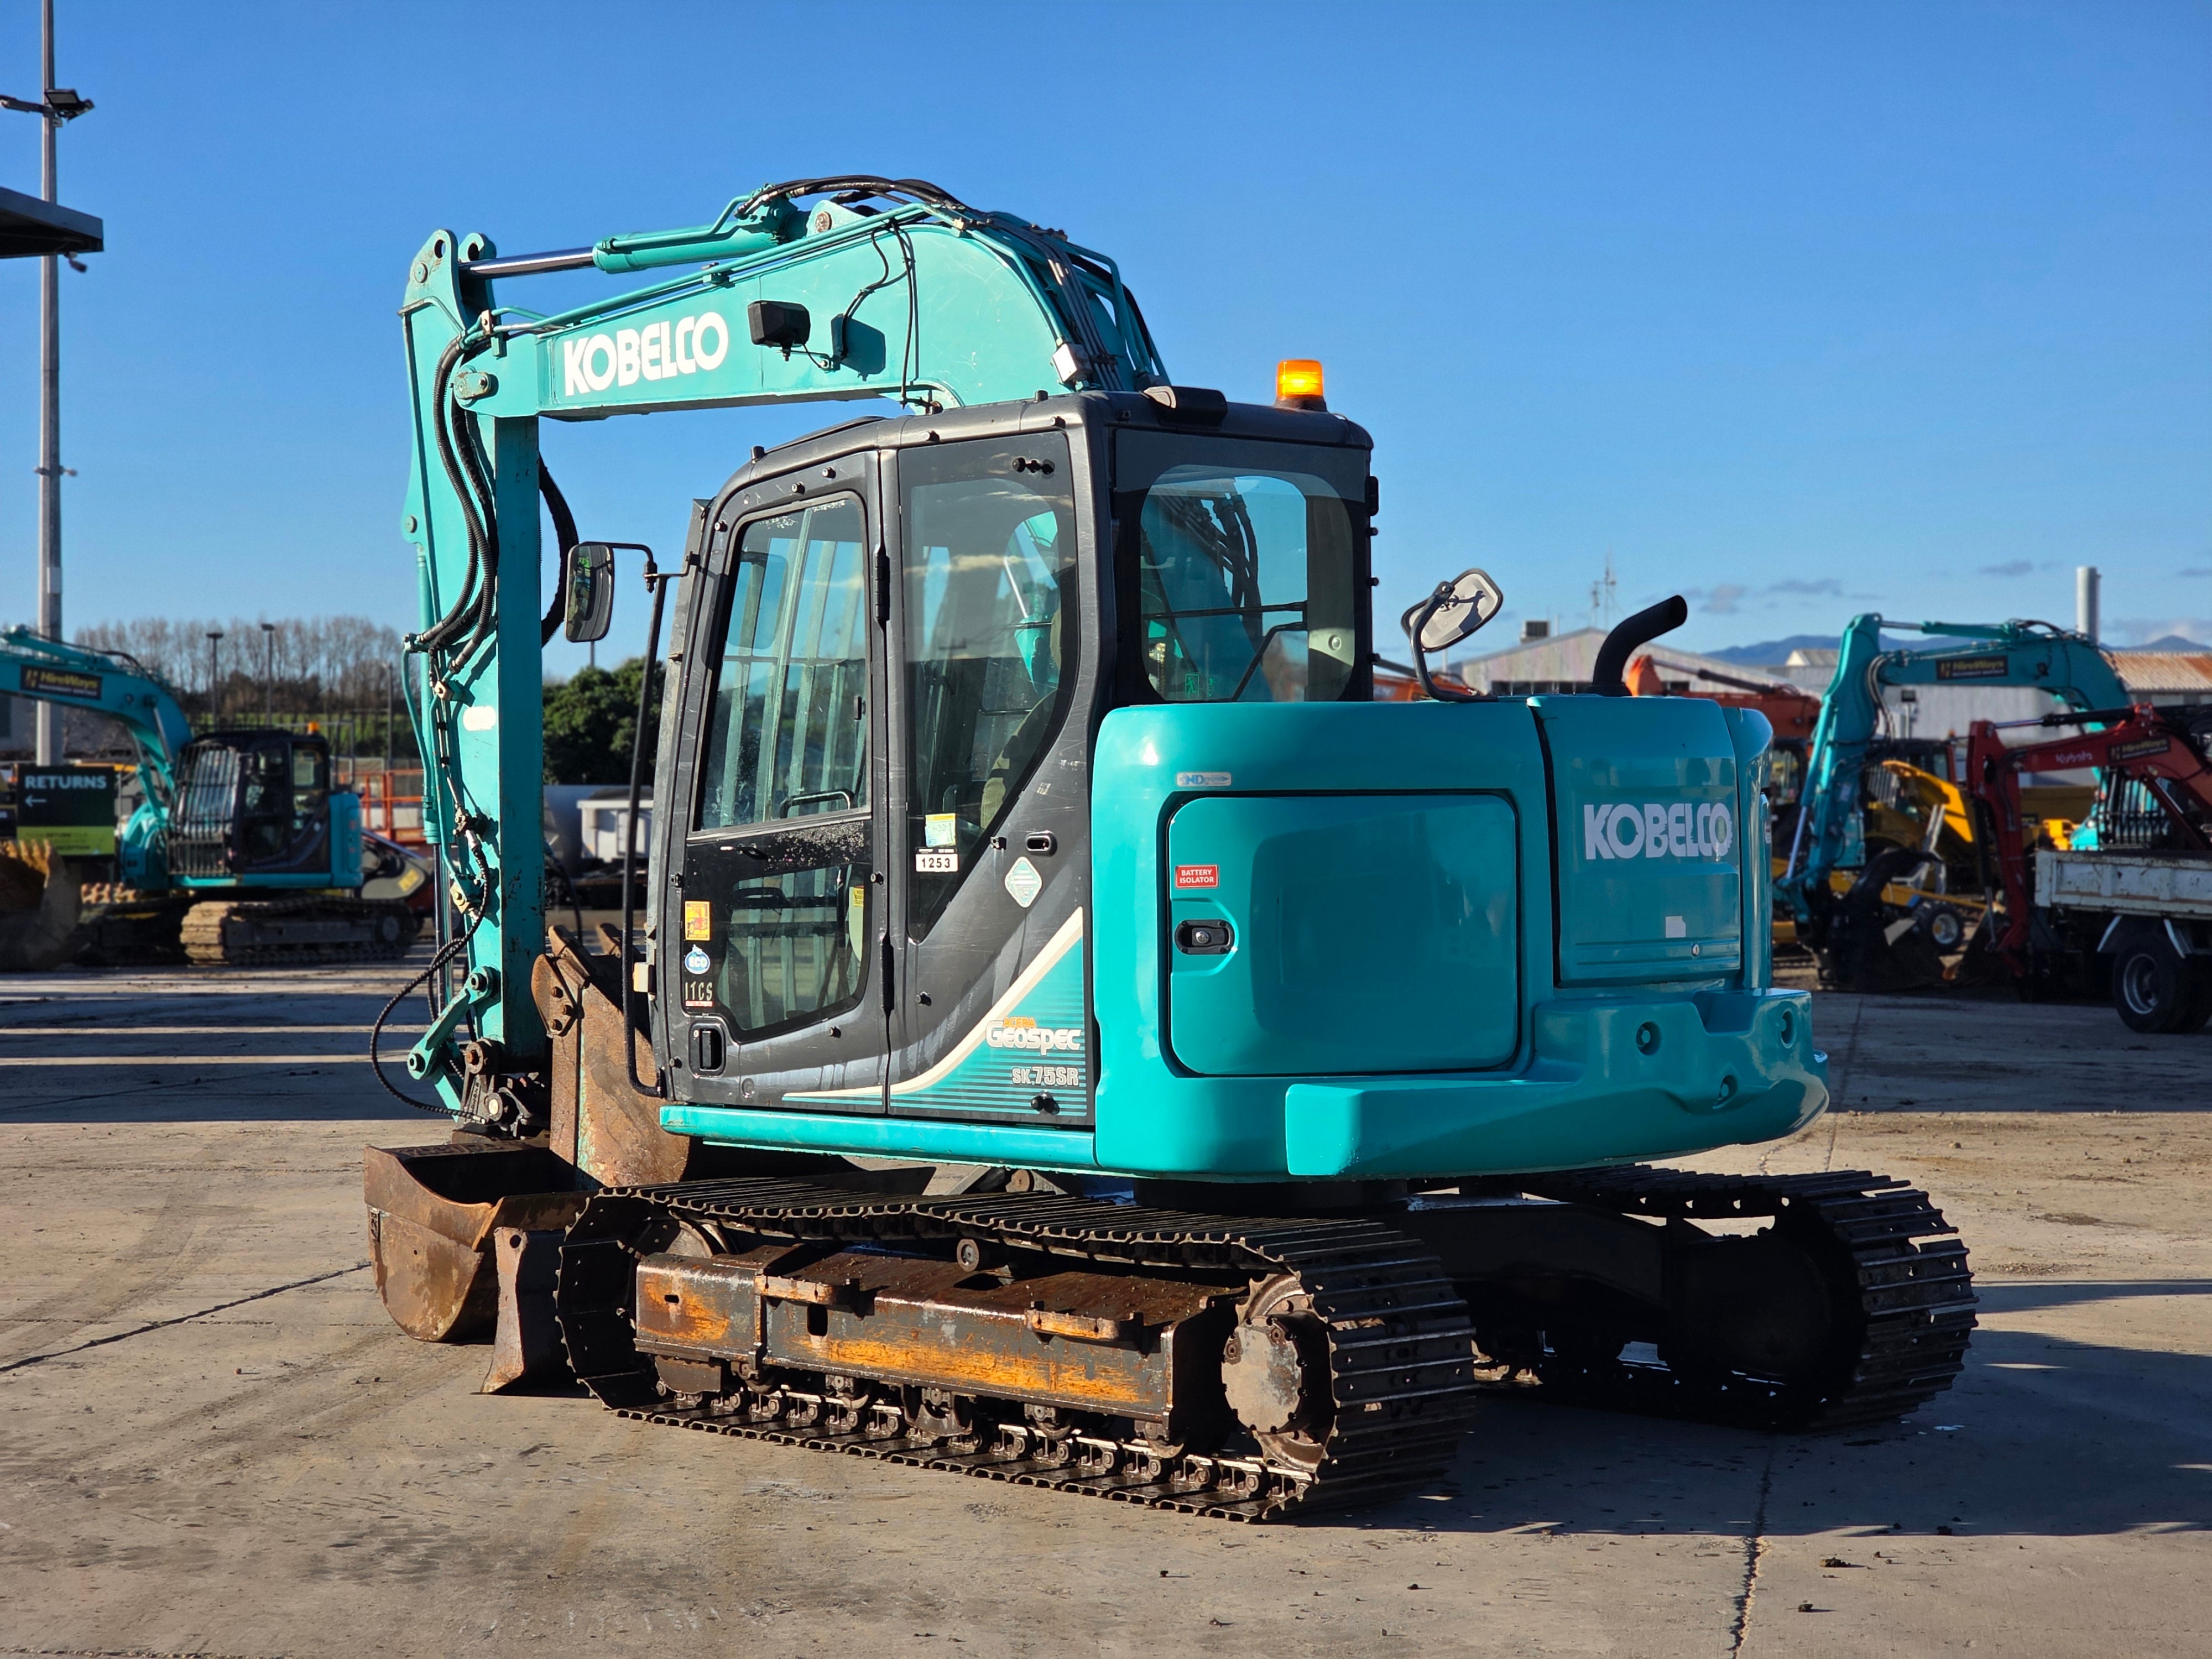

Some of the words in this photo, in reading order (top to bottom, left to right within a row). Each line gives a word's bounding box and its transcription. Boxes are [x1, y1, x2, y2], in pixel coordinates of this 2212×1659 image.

[564, 311, 729, 397] KOBELCO
[25, 775, 107, 789] RETURNS
[1583, 802, 1733, 860] KOBELCO
[921, 857, 950, 868] 1253
[688, 956, 708, 968] ECO
[685, 981, 713, 1001] ITCS
[1003, 1016, 1036, 1029] ACERA
